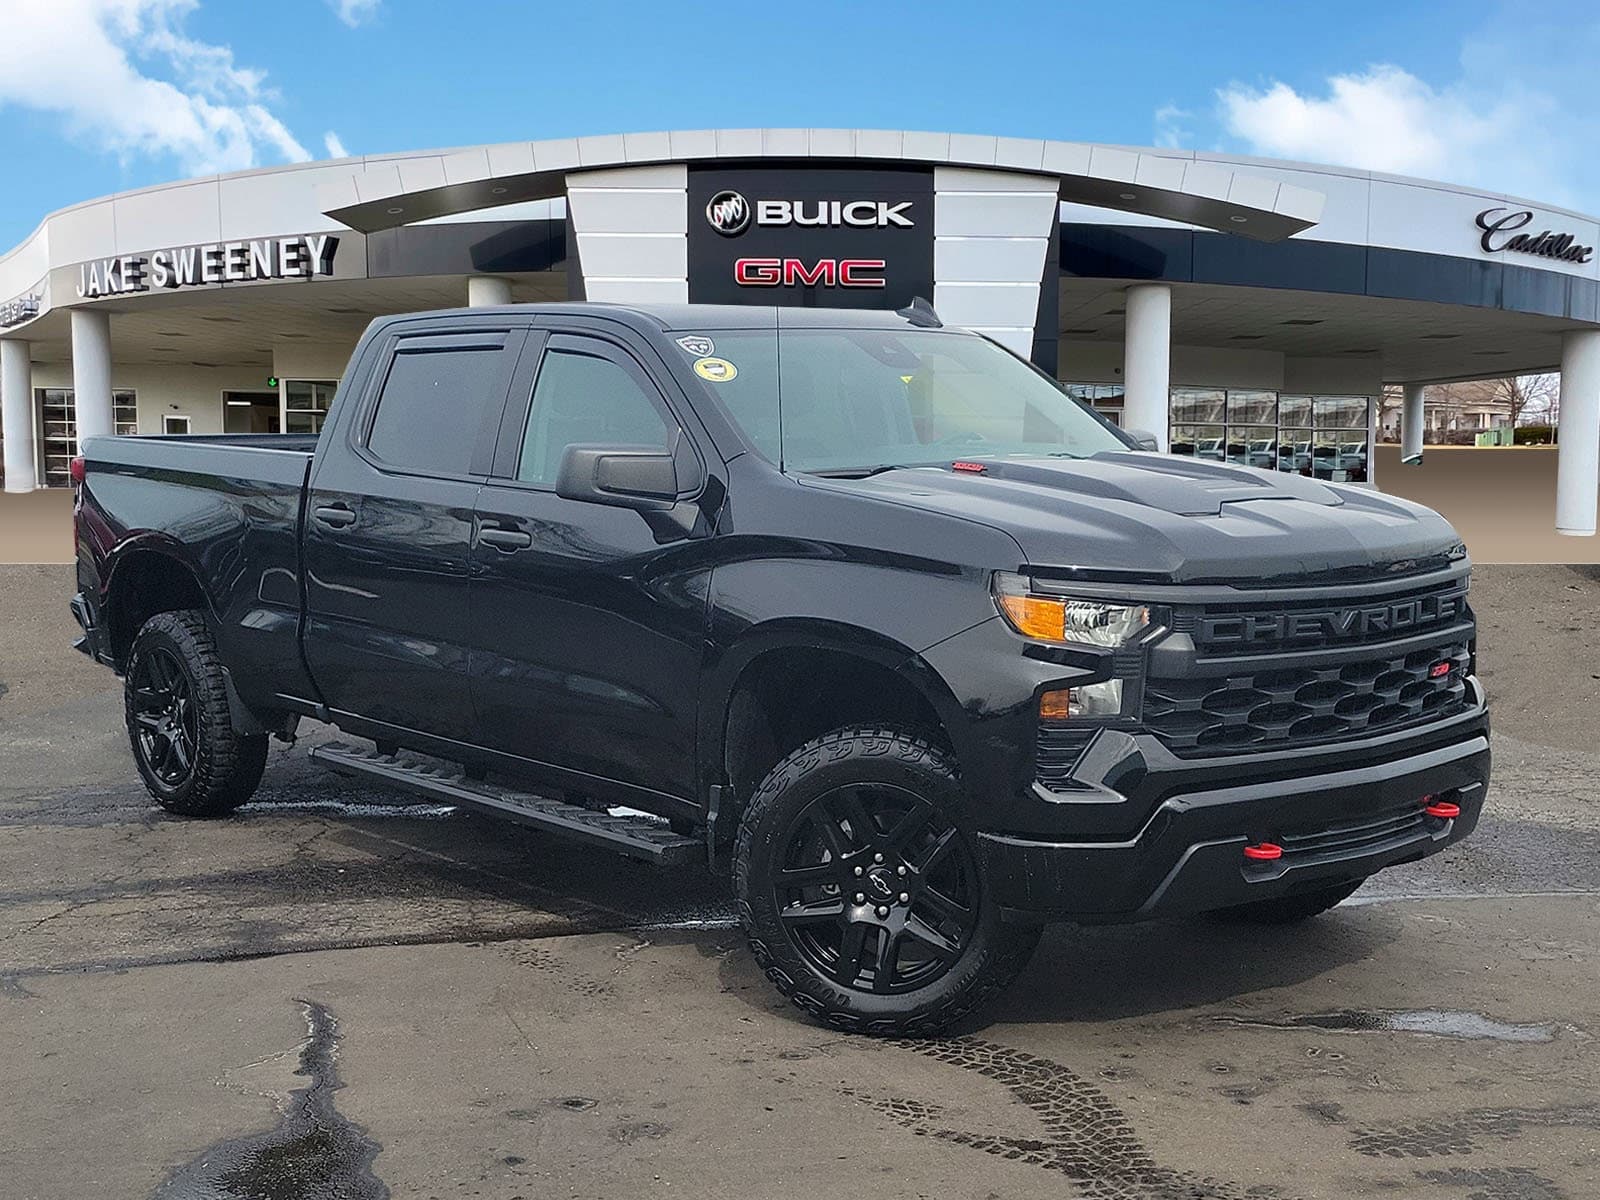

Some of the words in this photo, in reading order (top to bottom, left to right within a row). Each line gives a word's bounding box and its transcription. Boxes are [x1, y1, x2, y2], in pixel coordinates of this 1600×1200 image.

[757, 200, 915, 227] BUICK
[1475, 207, 1593, 263] Cadillac
[76, 255, 146, 298] JAKE
[151, 235, 334, 288] SWEENEY
[735, 257, 886, 287] GMC
[1200, 596, 1463, 641] CHEVROLE
